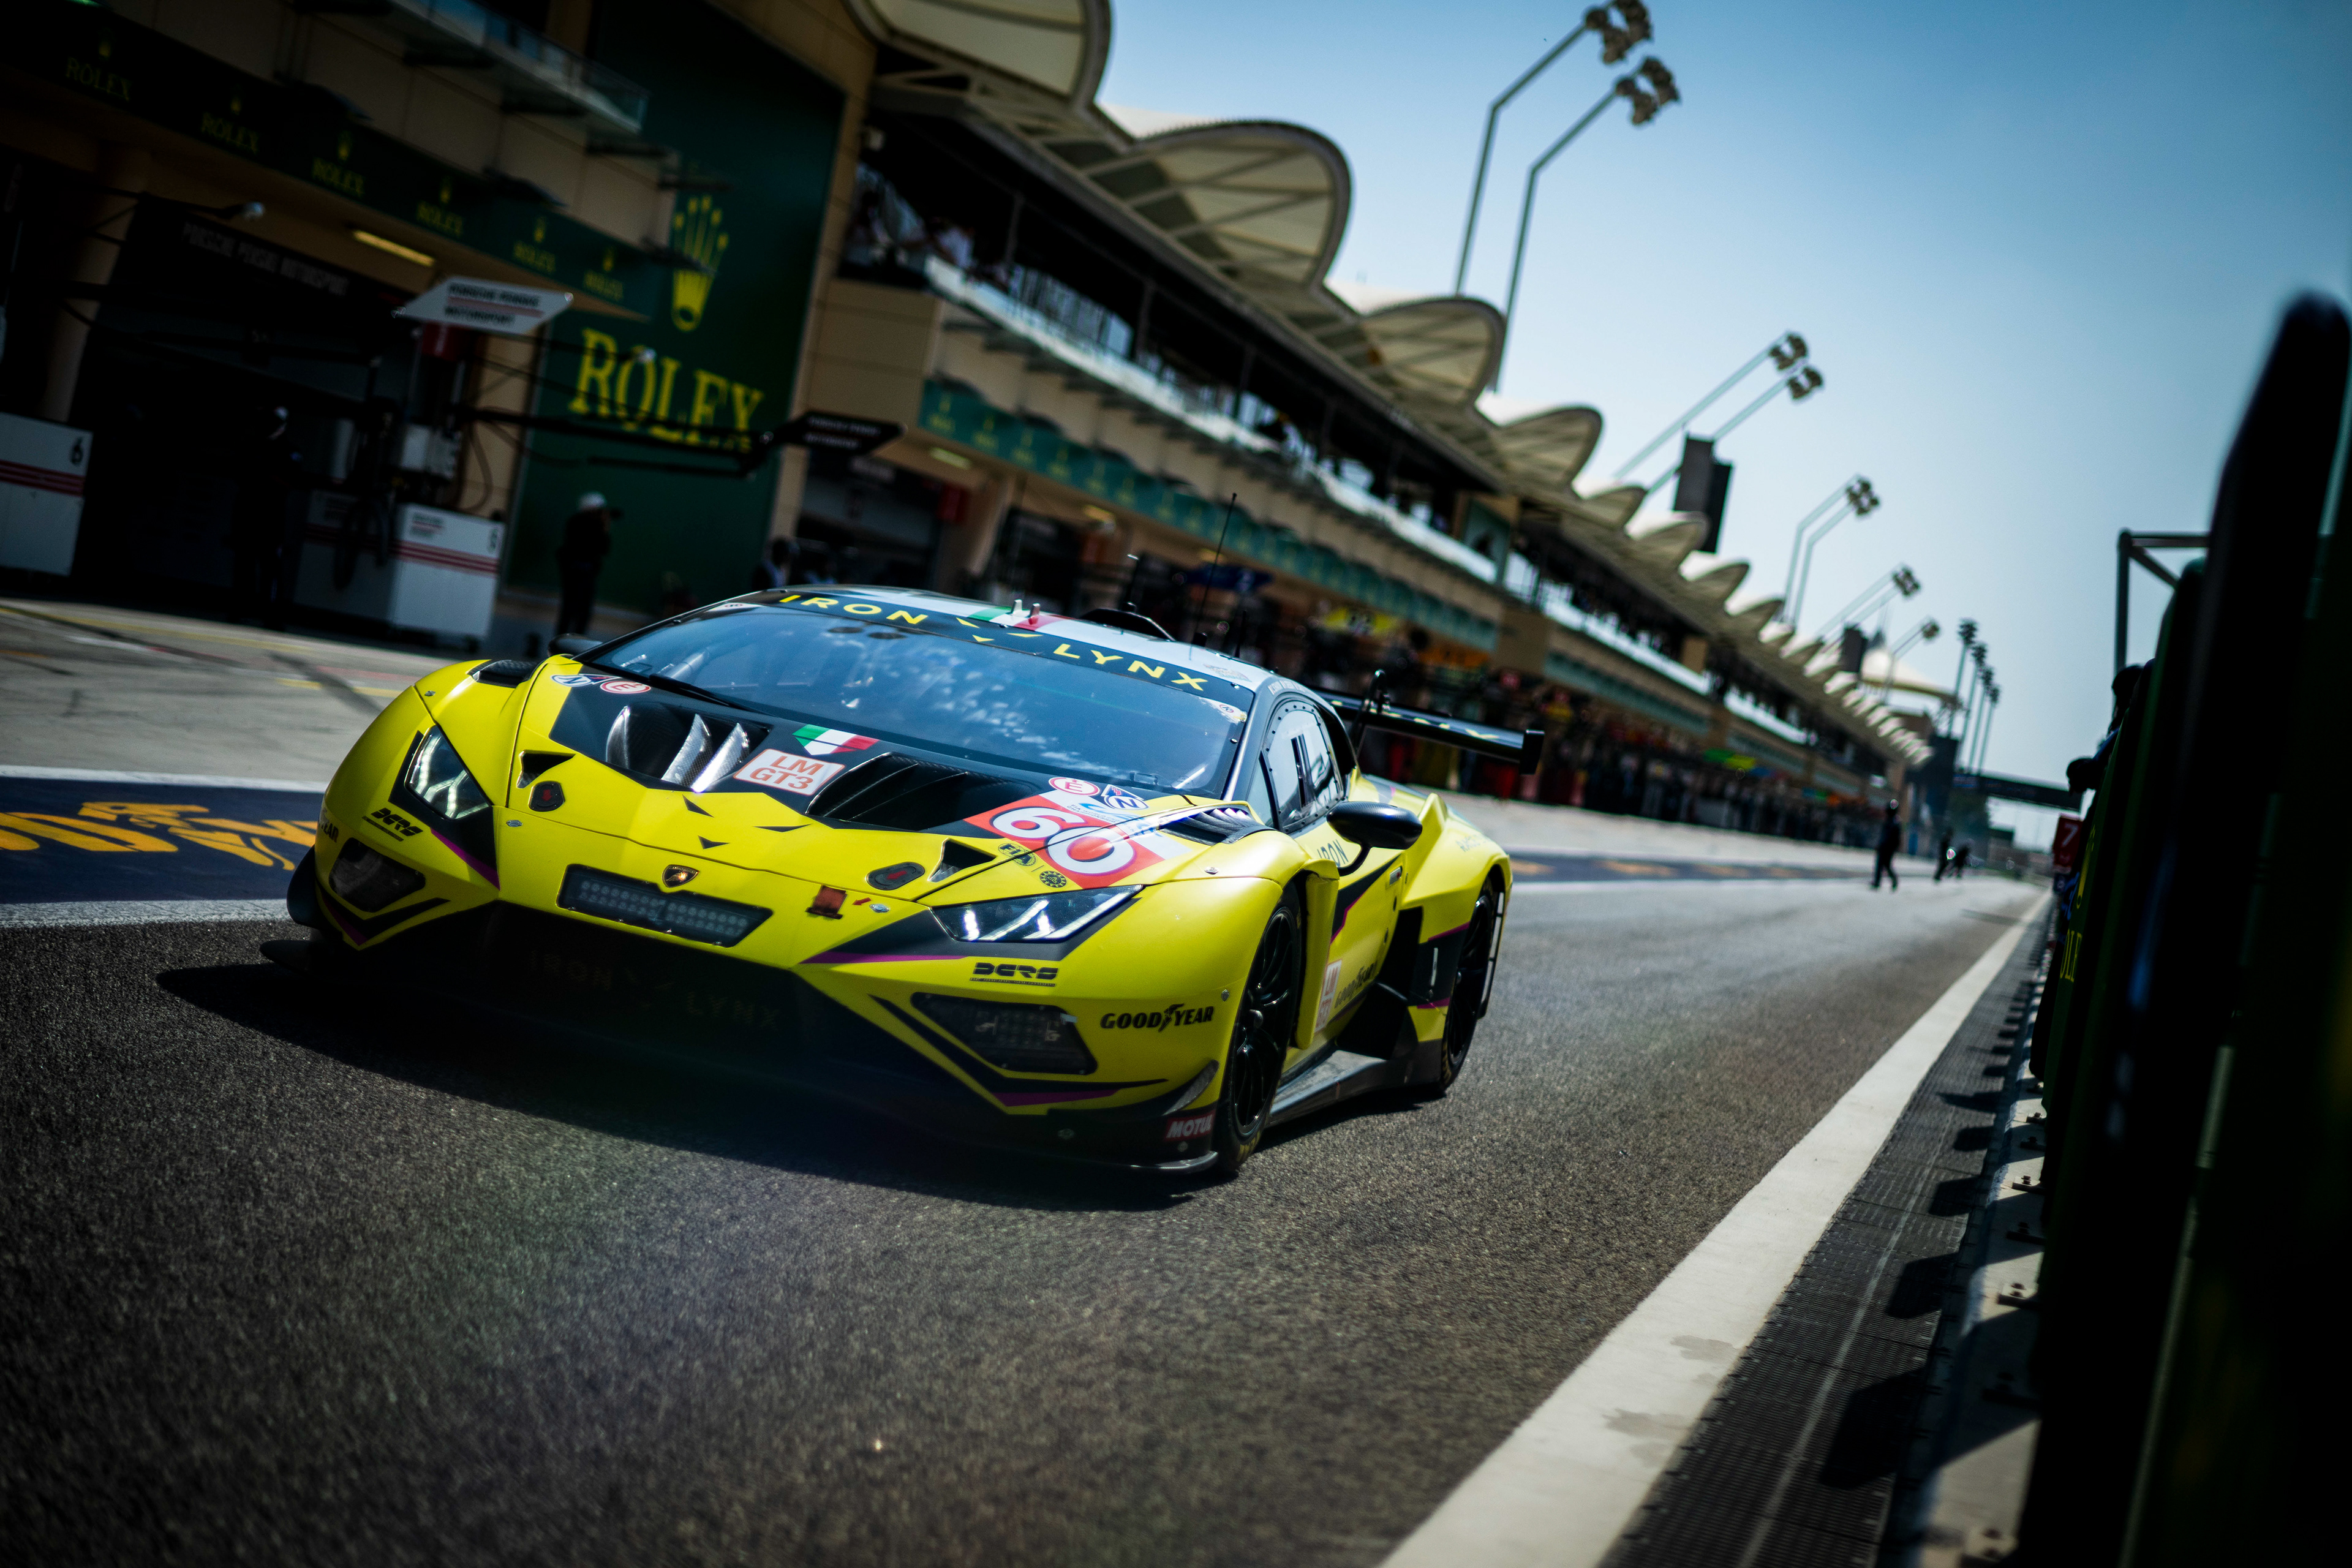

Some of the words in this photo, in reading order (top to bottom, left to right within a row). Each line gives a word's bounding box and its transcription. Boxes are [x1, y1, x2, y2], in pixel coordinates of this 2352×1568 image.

[64, 55, 134, 102] ROLEX
[200, 111, 260, 154] ROLEX
[312, 157, 365, 198] ROLEX
[568, 328, 764, 453] ROLEX
[71, 437, 83, 466] 6
[778, 594, 930, 625] IRON
[1053, 643, 1209, 692] LYNX
[749, 768, 814, 790] GT3
[770, 755, 824, 776] LM
[990, 807, 1137, 876] 60
[2061, 822, 2079, 848] 7
[1099, 1005, 1215, 1031] GOODYEAR
[1166, 1114, 1213, 1139] MOTUL
